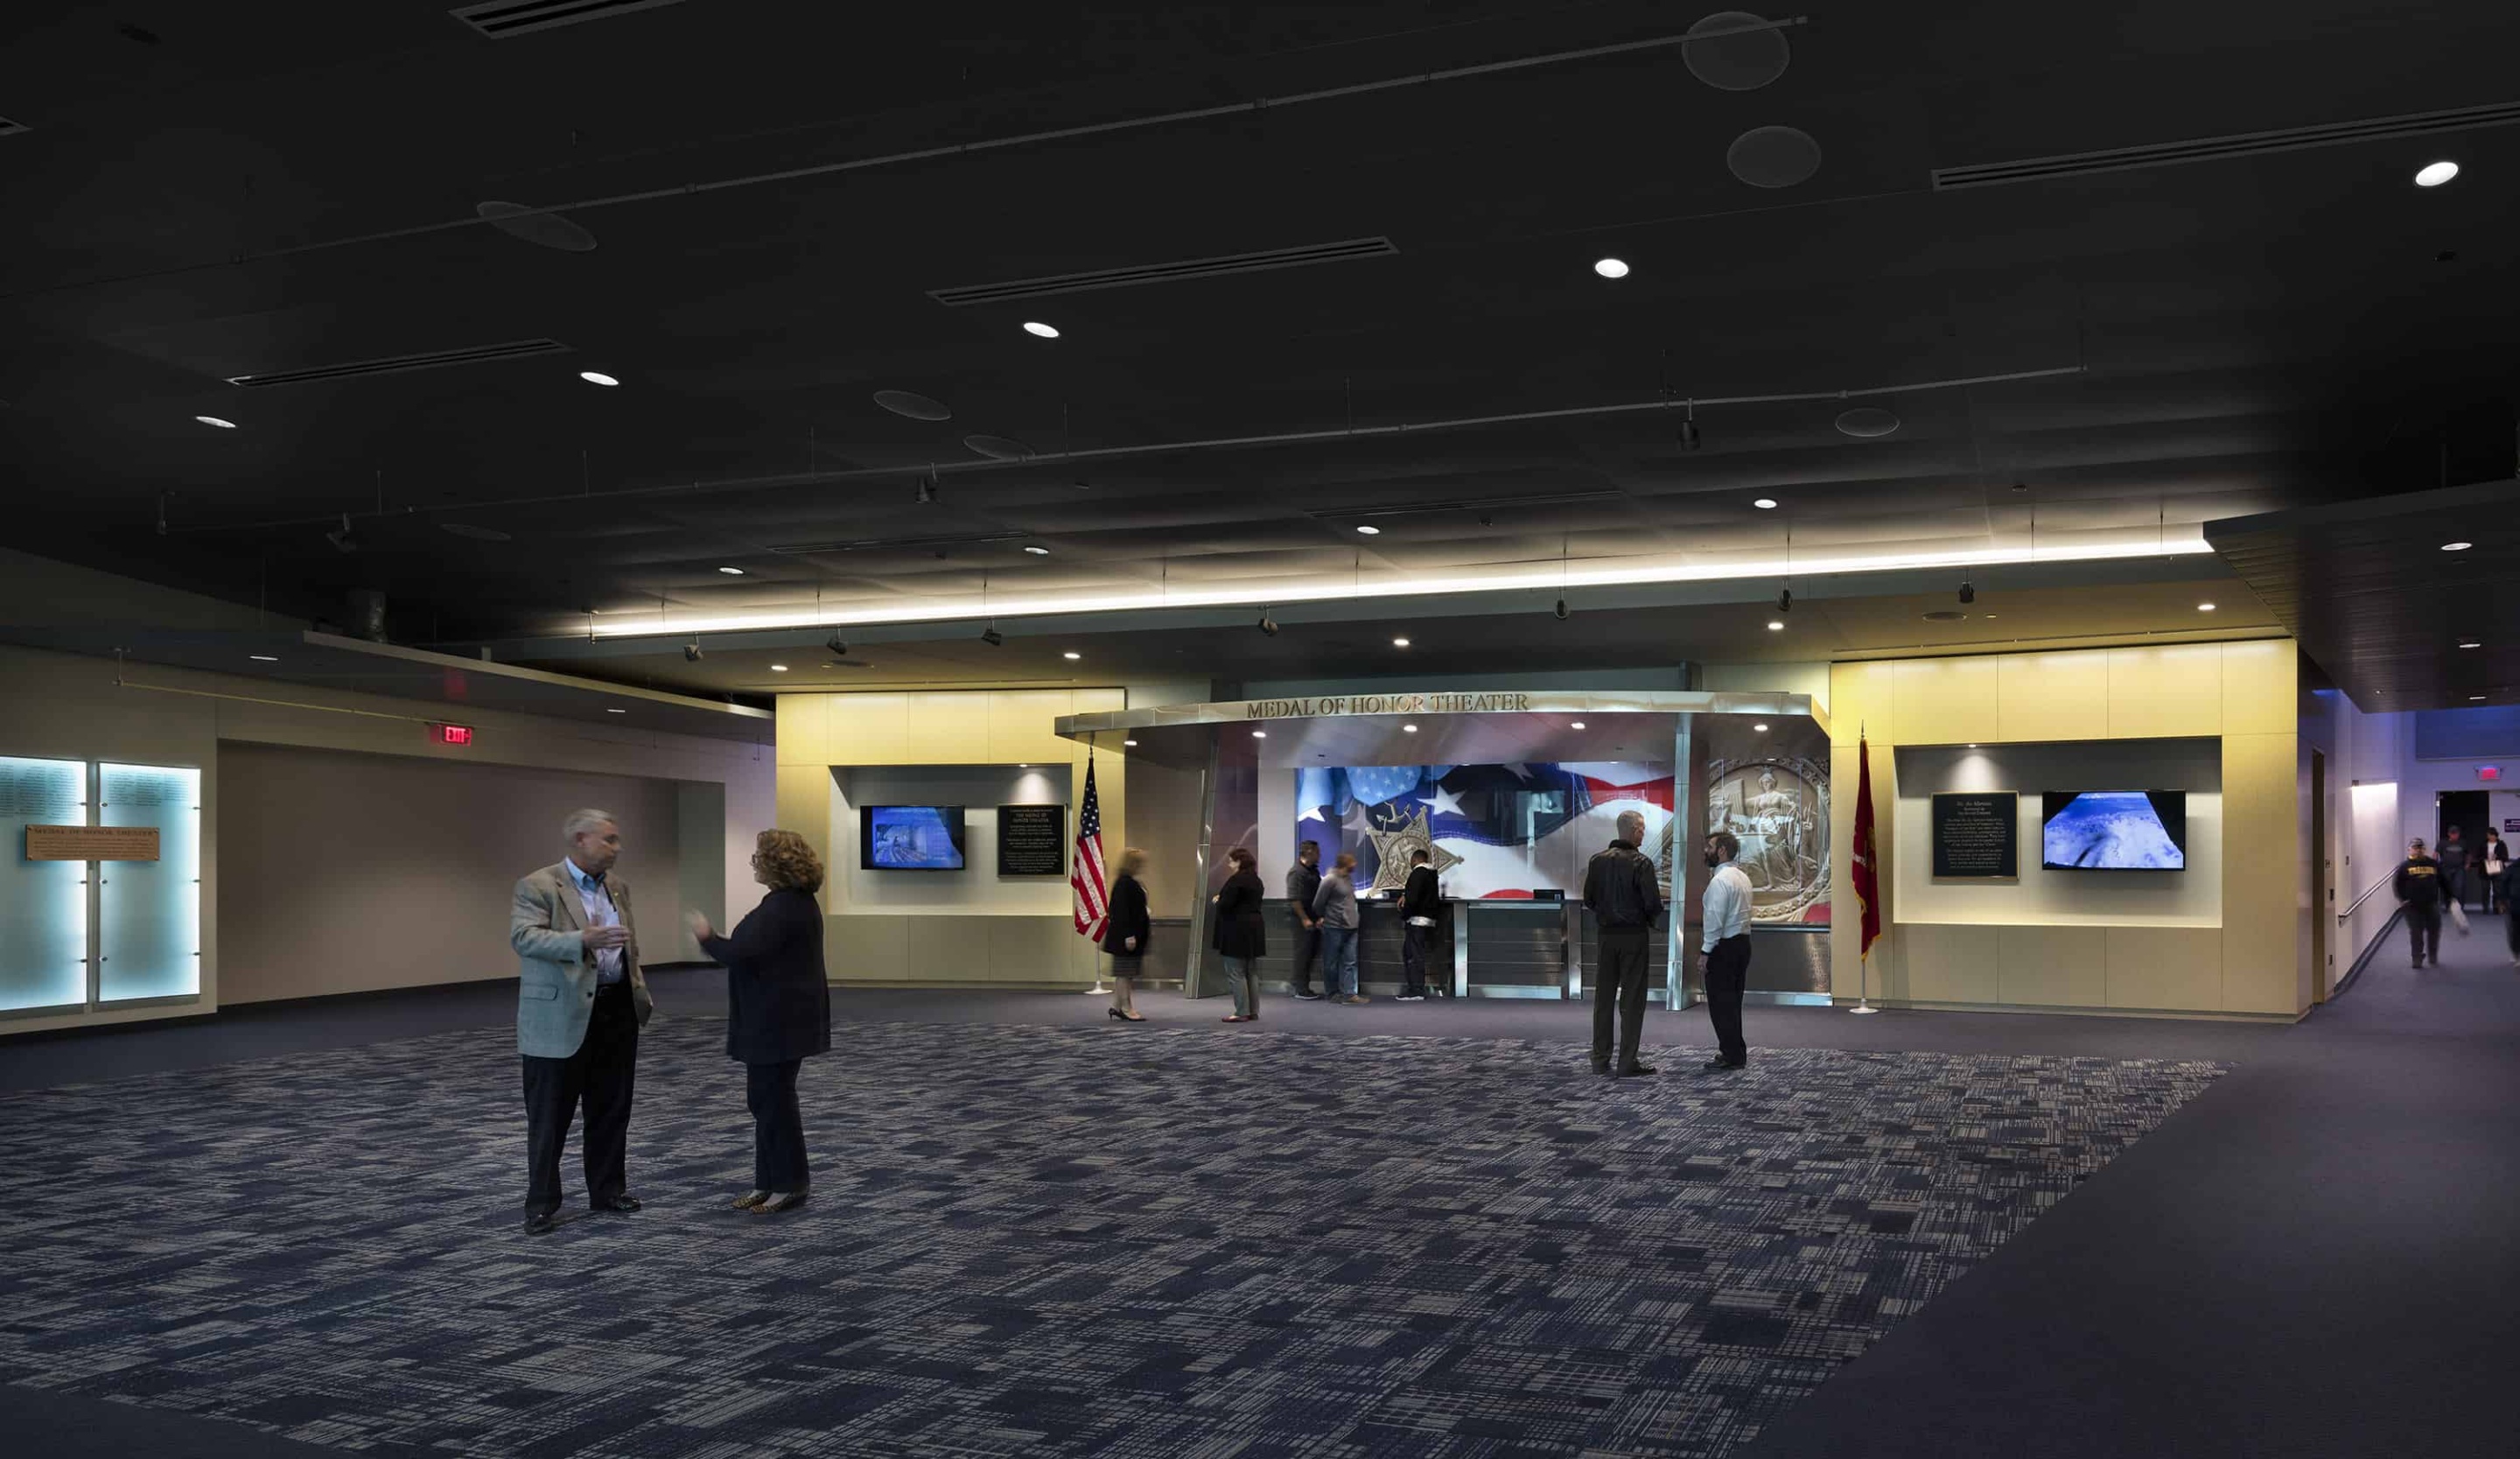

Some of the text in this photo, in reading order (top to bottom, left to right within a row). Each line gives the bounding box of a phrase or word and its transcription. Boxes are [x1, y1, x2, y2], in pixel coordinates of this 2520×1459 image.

[1247, 693, 1530, 719] MEDAL OF HONOR THEATER
[445, 726, 466, 743] EXIT
